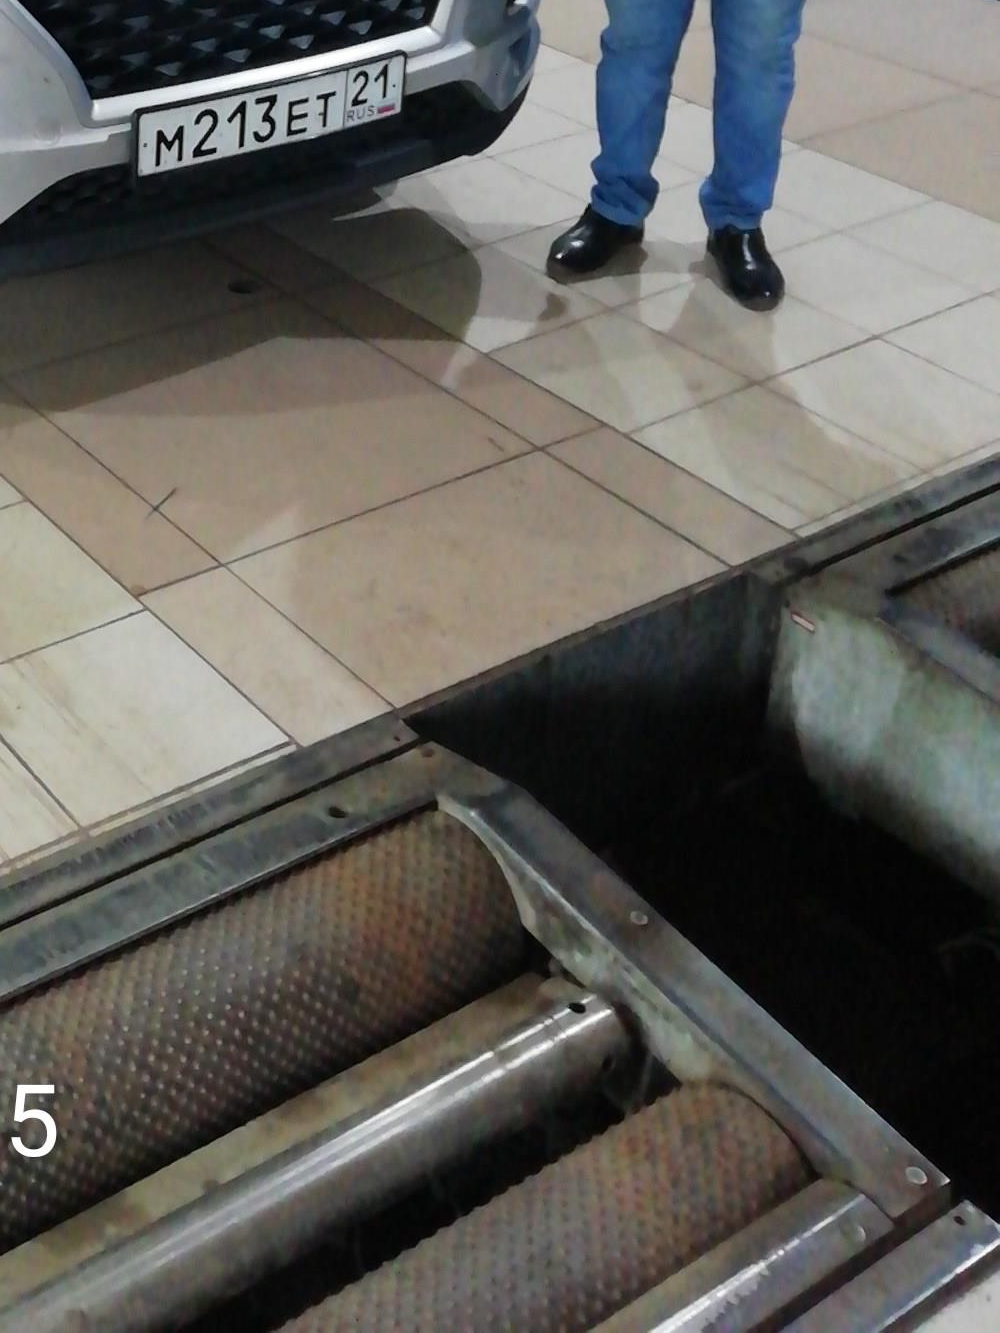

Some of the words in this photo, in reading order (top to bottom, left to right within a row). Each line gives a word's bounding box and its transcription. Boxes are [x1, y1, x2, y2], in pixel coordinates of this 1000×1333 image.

[155, 91, 337, 167] М213ЕТ
[350, 63, 390, 107] 21
[345, 104, 377, 123] RUS
